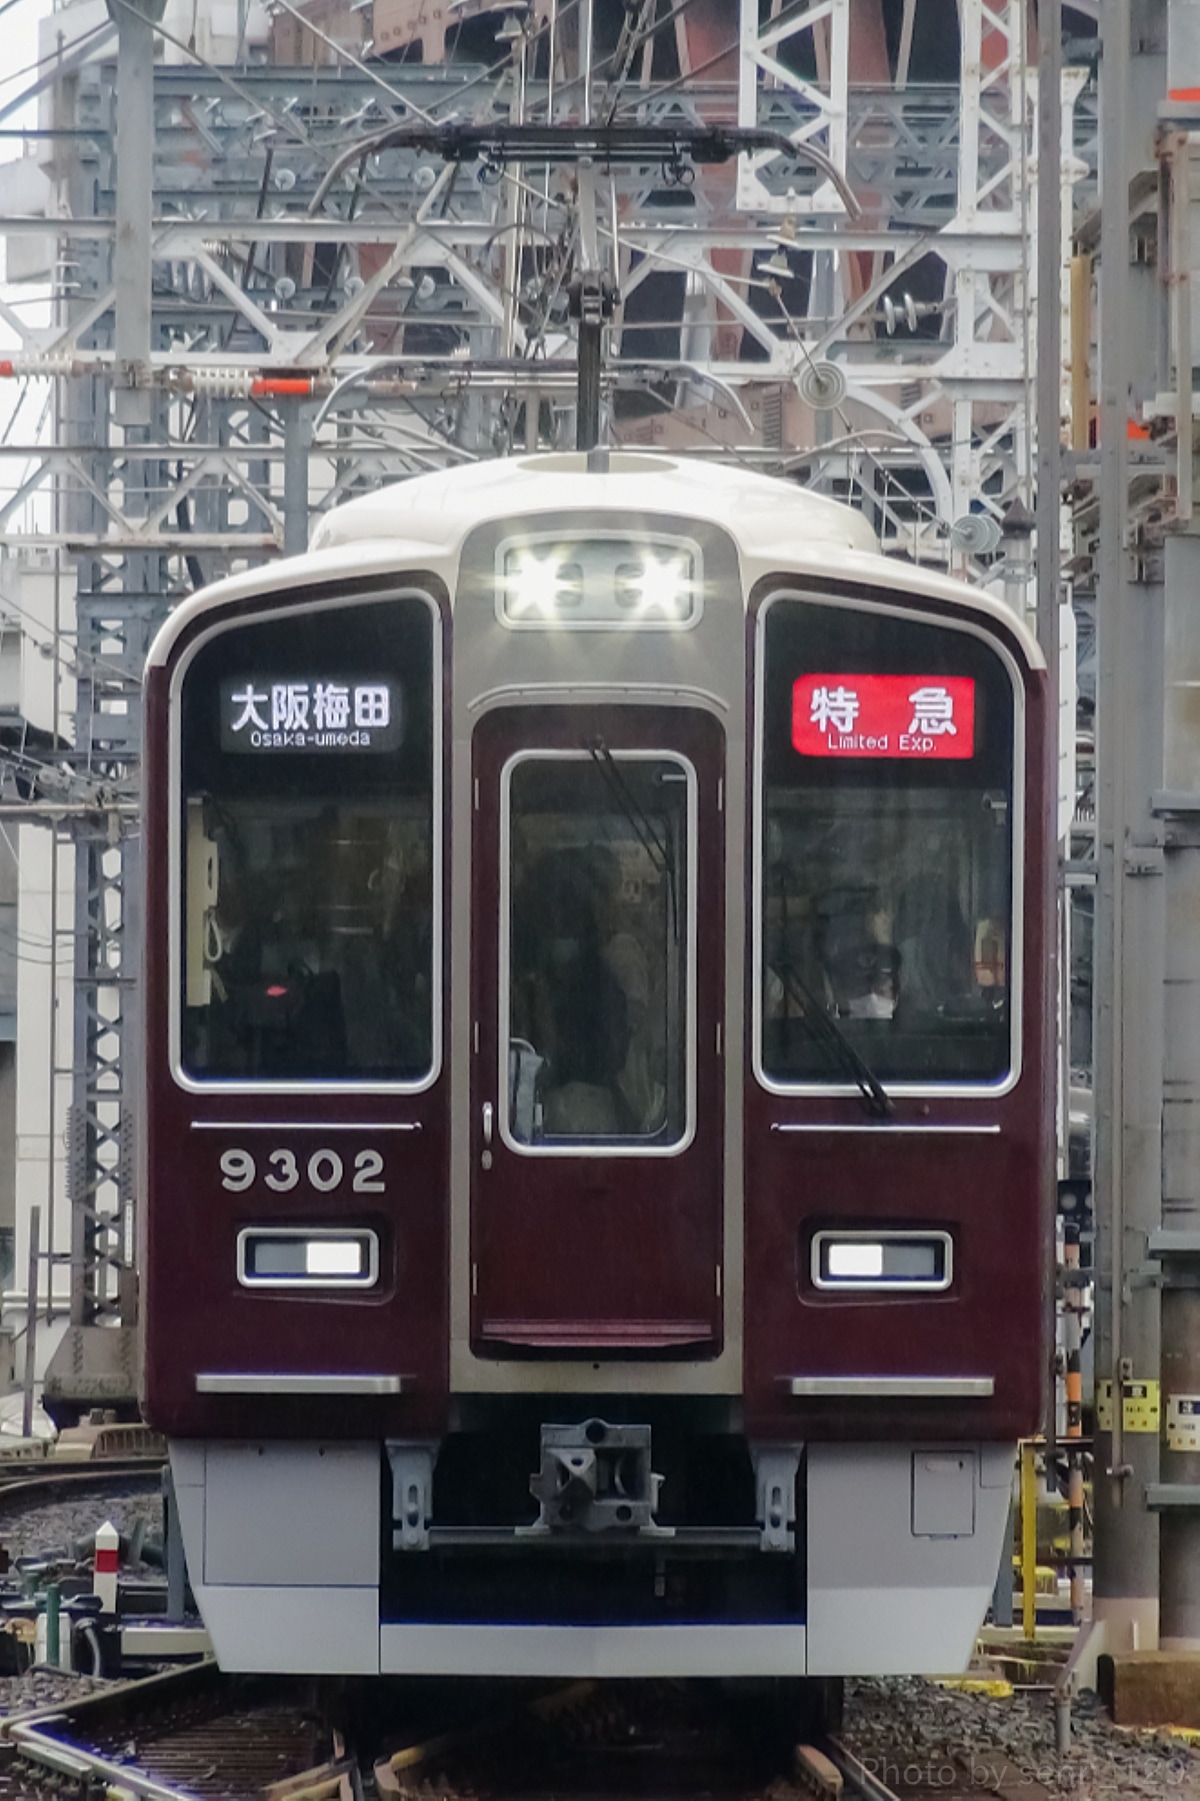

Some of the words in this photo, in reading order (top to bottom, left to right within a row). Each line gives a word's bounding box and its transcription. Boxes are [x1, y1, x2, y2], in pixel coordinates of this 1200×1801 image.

[231, 683, 390, 731] 大阪梅田
[828, 733, 888, 749] Limited
[899, 734, 937, 752] Exp.
[219, 1148, 386, 1193] 9302
